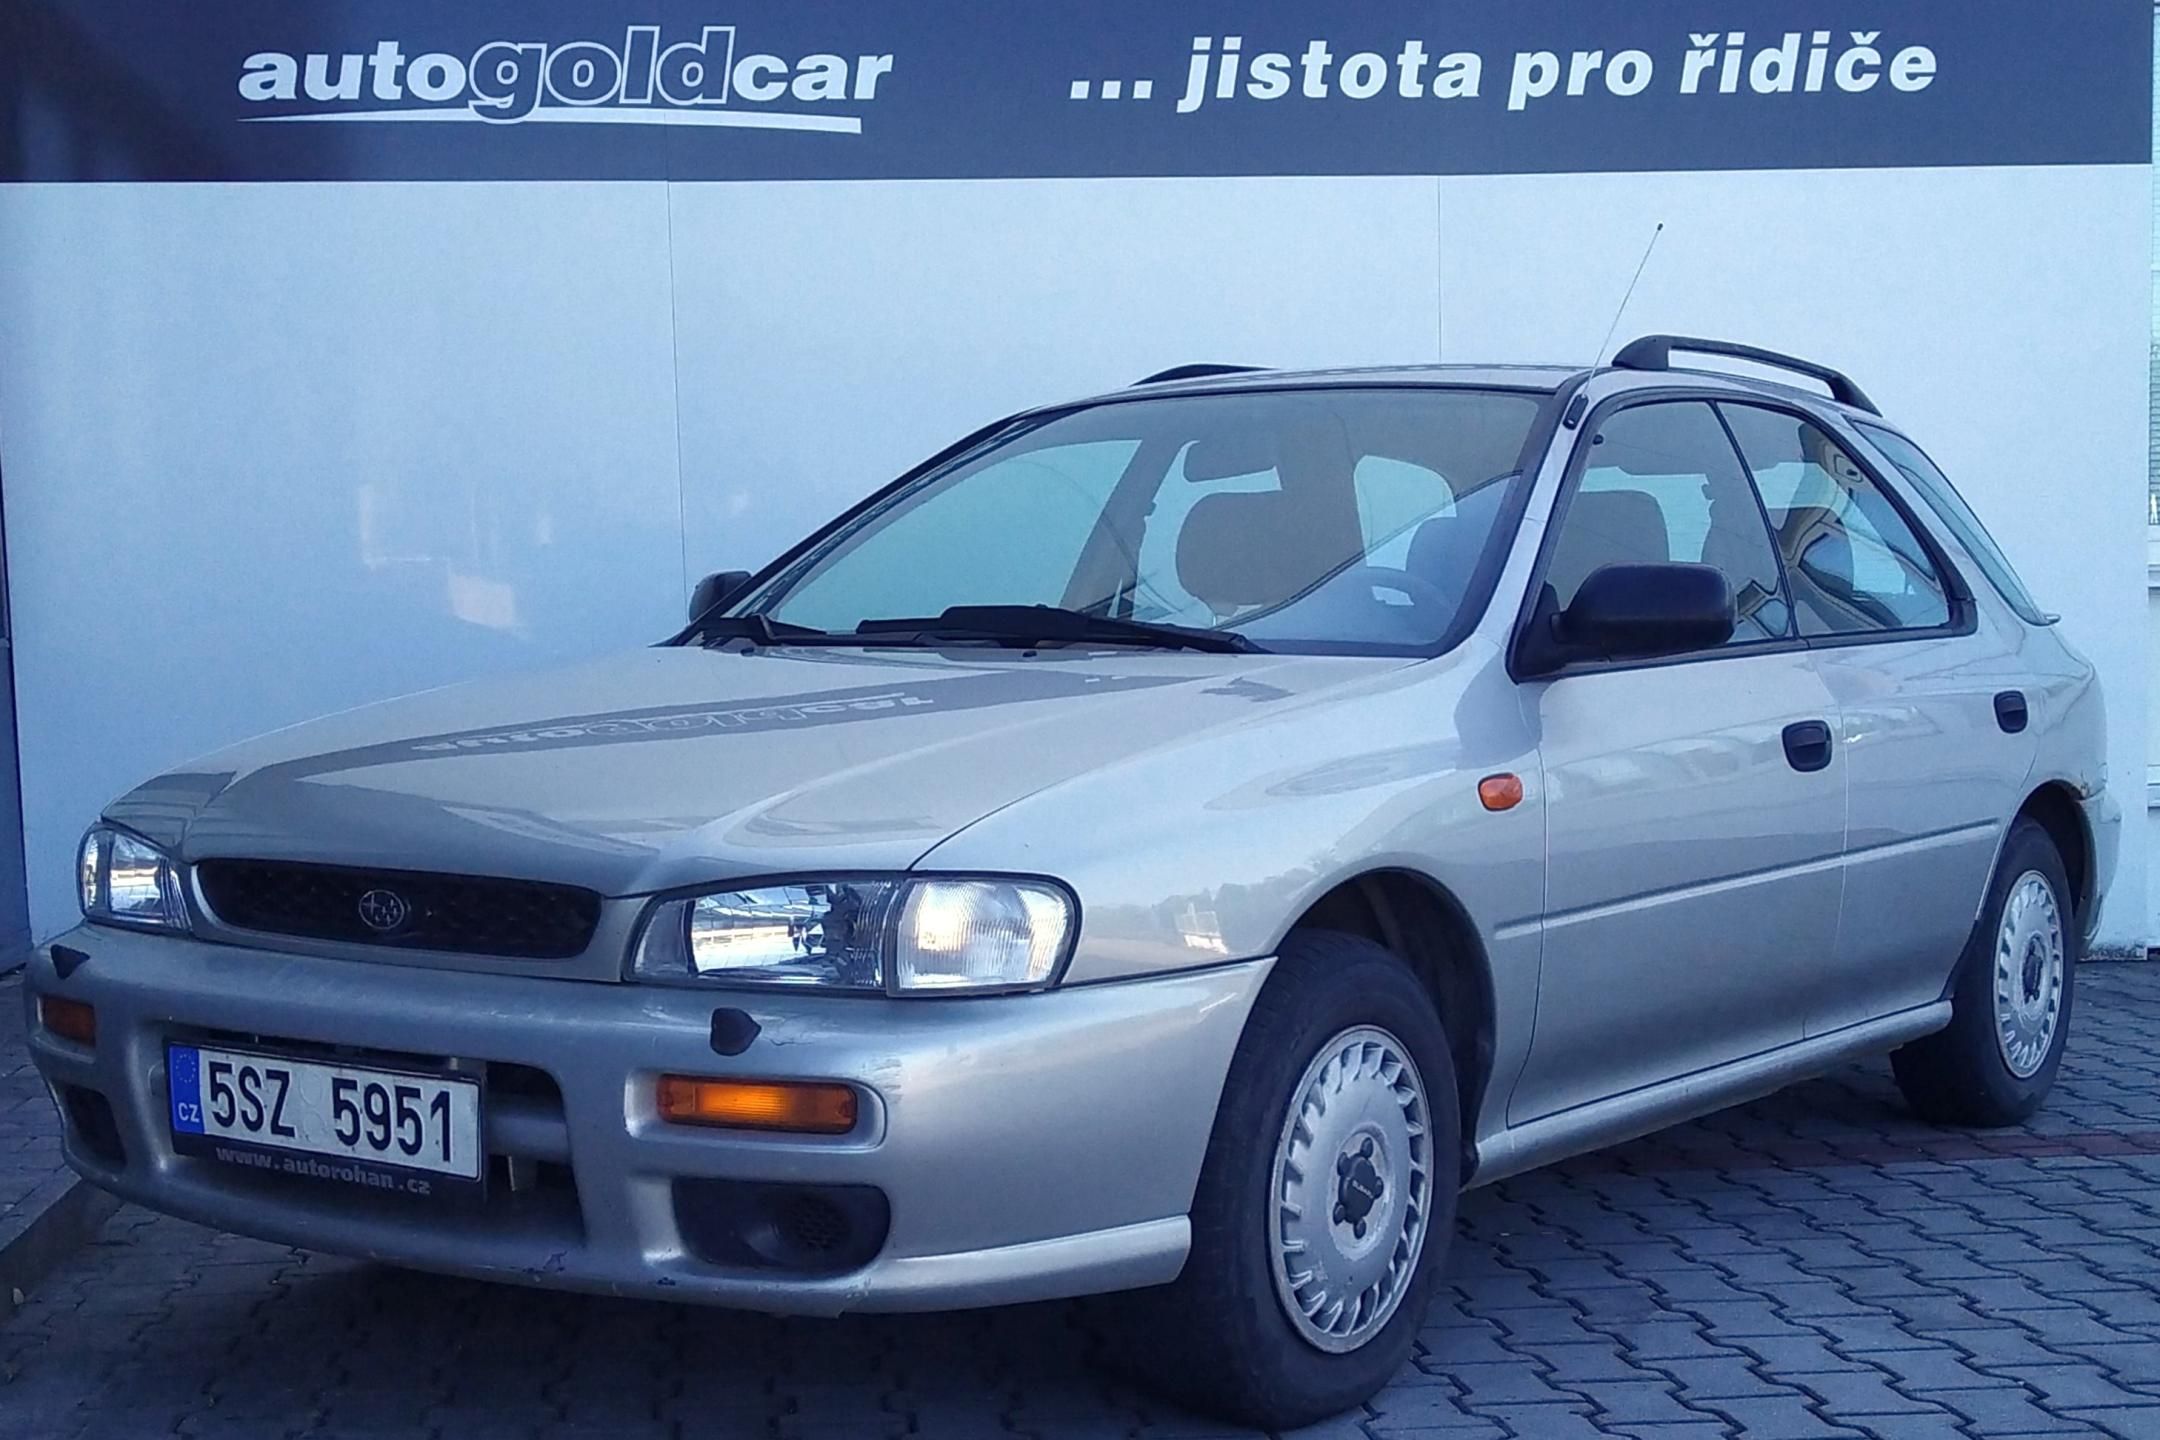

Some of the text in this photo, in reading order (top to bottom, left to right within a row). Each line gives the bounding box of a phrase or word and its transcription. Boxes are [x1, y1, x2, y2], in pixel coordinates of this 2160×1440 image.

[238, 25, 894, 123] autogoldcar
[1176, 36, 1481, 114] jistota
[1507, 49, 1653, 111] pro
[1679, 30, 1937, 94] řidiče
[178, 1061, 452, 1163] CZ 5SZ 5951
[216, 1147, 432, 1195] www.autorohan.cz
